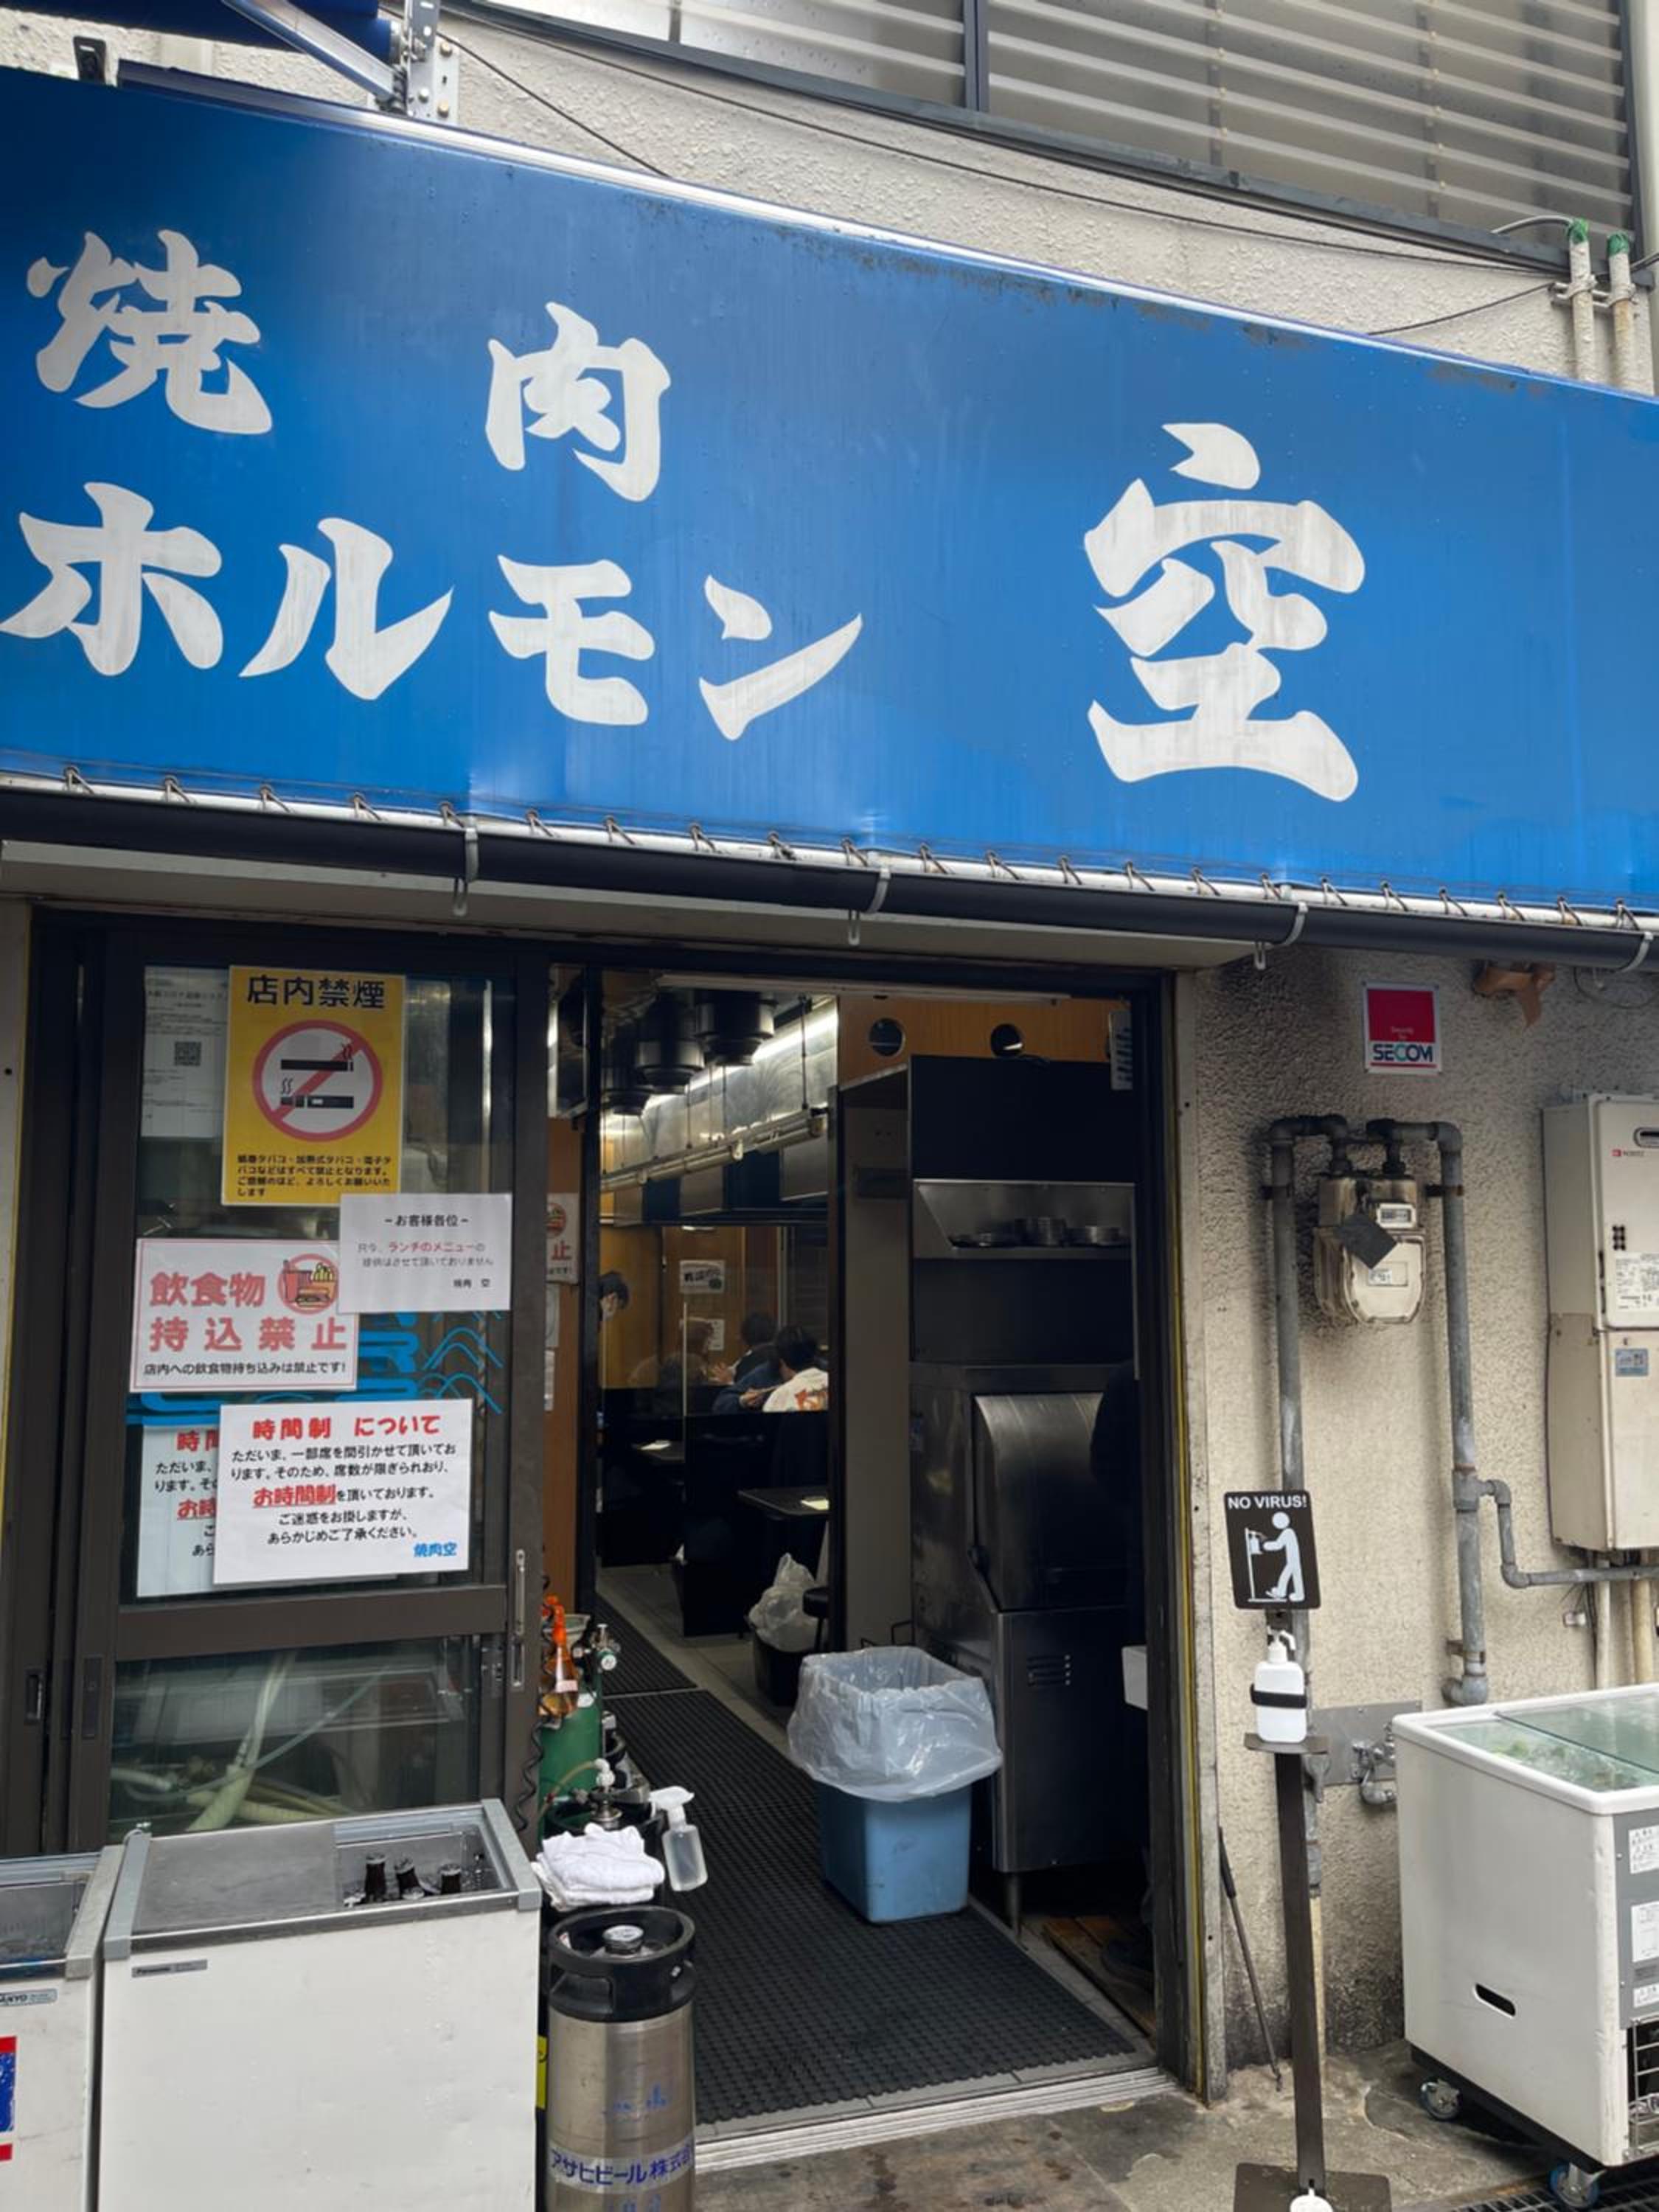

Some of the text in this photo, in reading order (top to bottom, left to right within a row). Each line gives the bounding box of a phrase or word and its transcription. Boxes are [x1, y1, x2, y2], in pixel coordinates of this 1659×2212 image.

[0, 482, 863, 740] ホルモン
[1084, 422, 1366, 802] 空
[247, 975, 386, 1009] 店内禁煙
[1372, 1043, 1433, 1062] SECOM
[150, 1270, 267, 1308] 飲食物
[150, 1316, 347, 1353] 持込禁止
[252, 1414, 441, 1439] 時間制 について
[1228, 1495, 1307, 1509] NO VIRUS!
[267, 1526, 418, 1545] あらかじめご了承ください。
